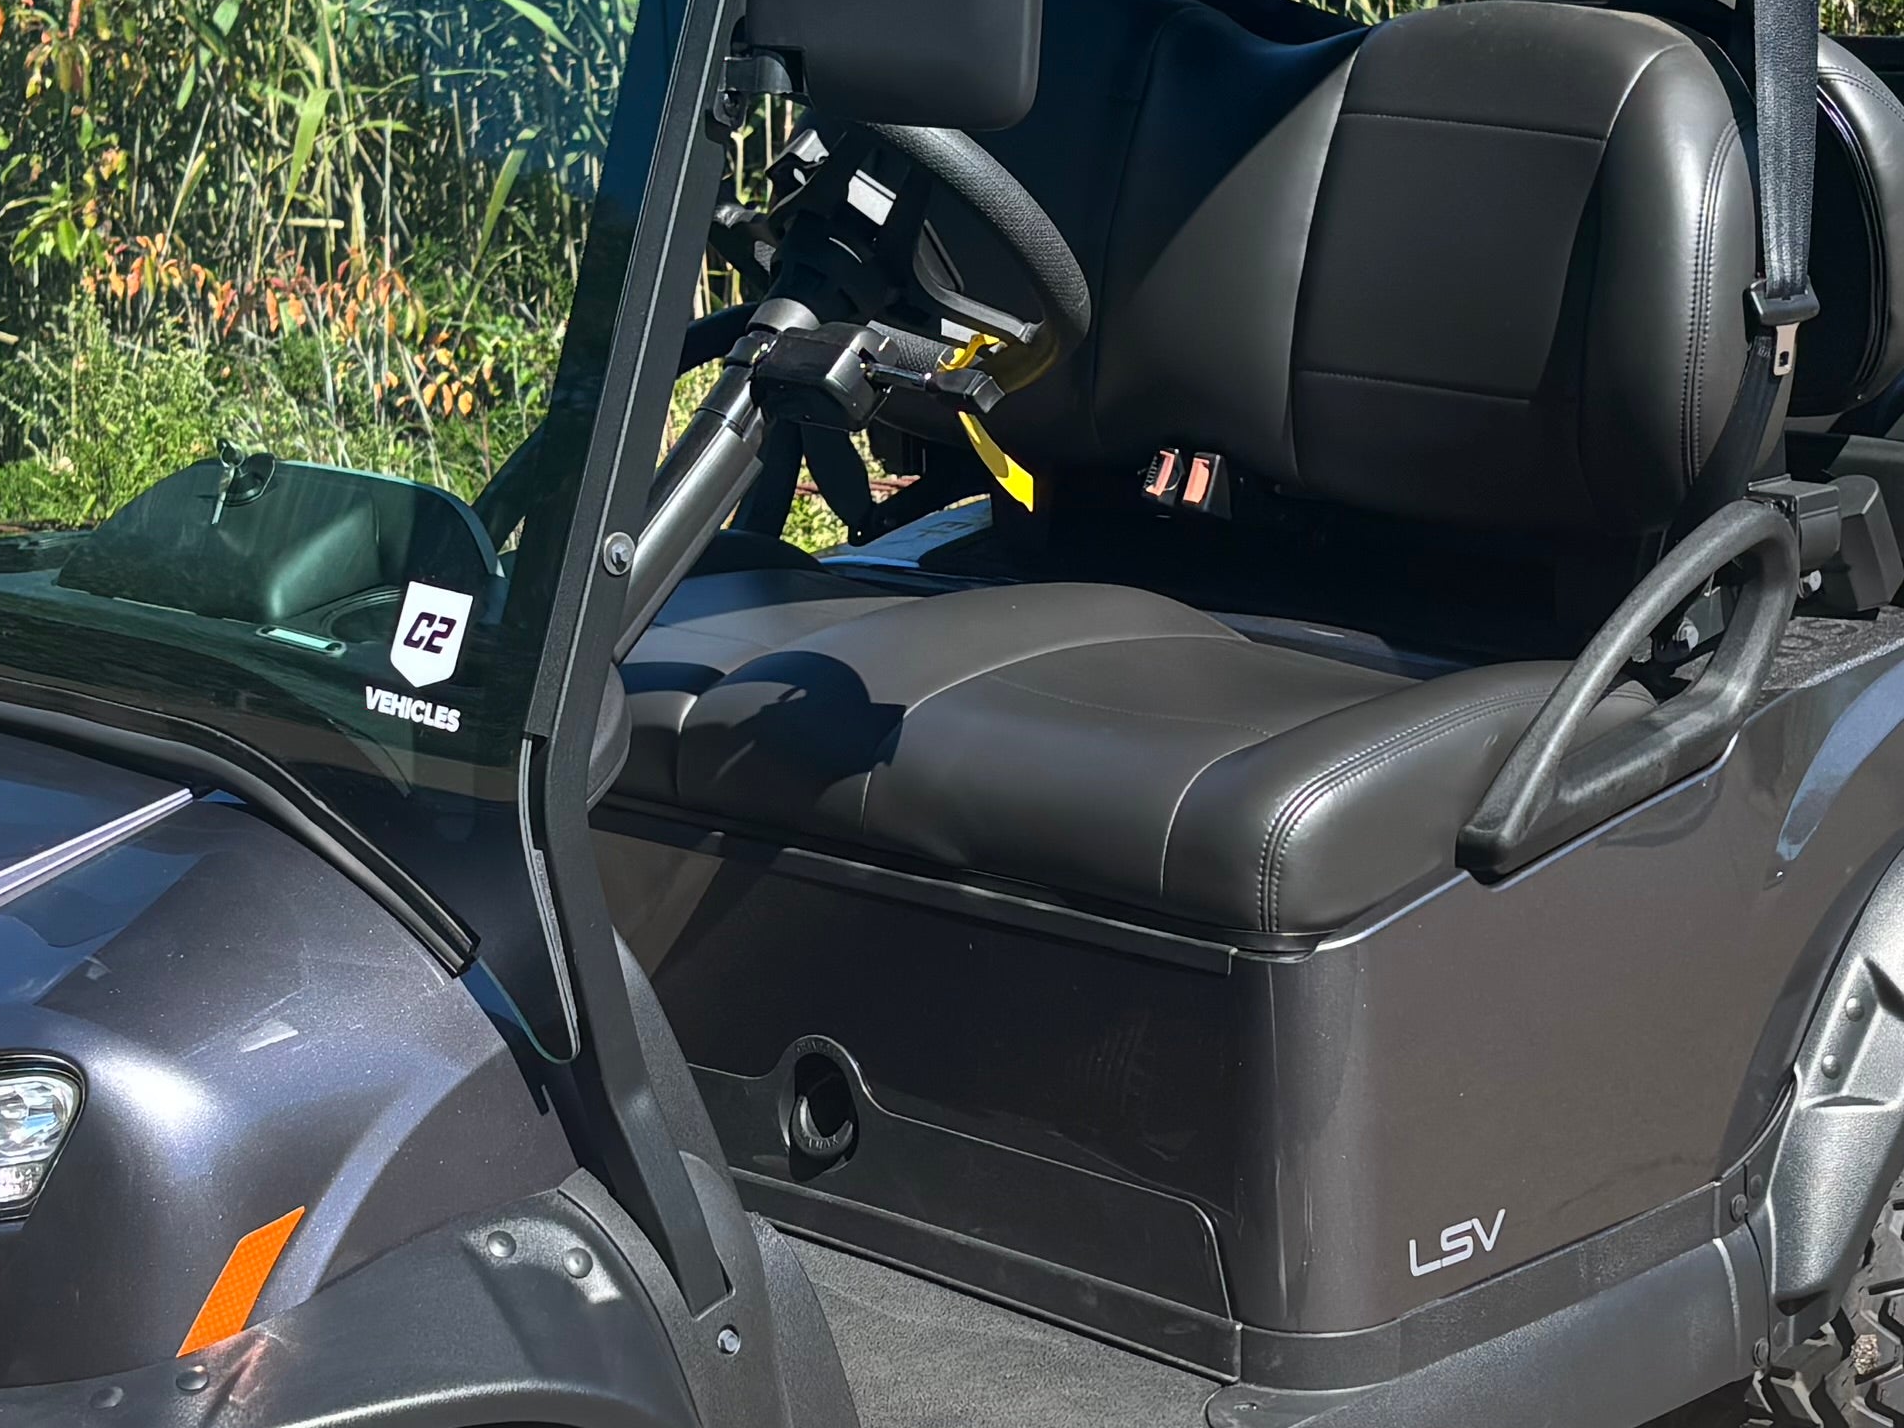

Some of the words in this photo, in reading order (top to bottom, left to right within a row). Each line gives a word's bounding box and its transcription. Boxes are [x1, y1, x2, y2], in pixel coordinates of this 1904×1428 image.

[403, 611, 457, 655] C2
[365, 685, 461, 733] VEHICLES
[1408, 1208, 1506, 1277] LSV
